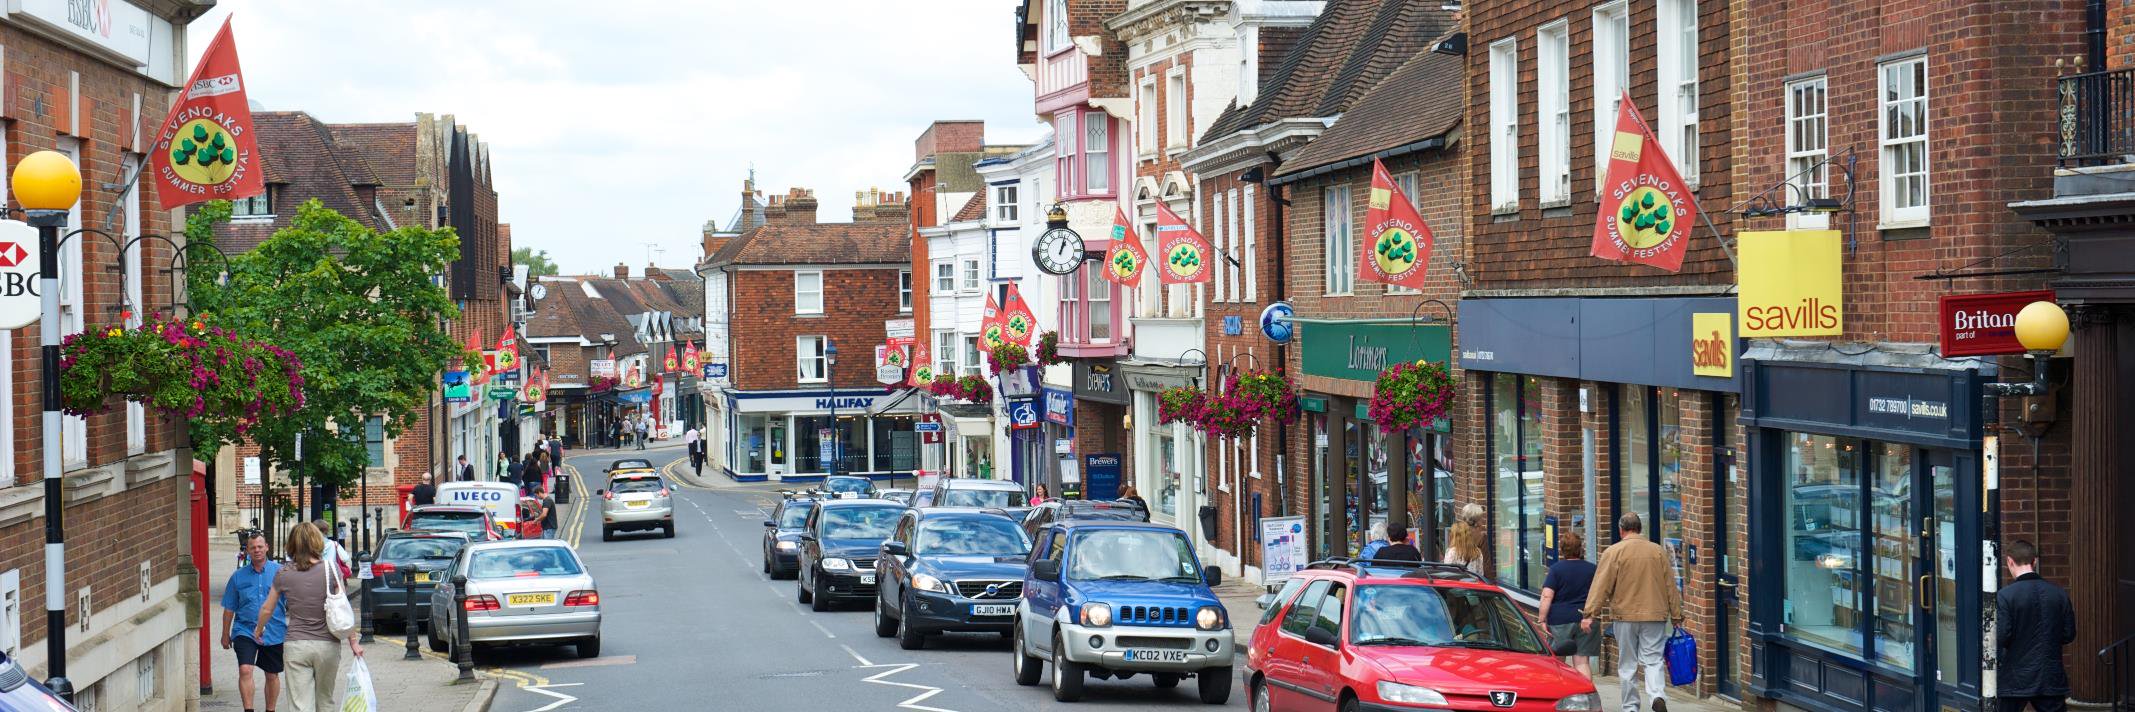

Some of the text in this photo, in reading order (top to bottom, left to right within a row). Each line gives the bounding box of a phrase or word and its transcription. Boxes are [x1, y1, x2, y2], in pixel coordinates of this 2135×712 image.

[67, 0, 97, 33] HSBC
[160, 106, 243, 150] SEVENOAKS
[1613, 149, 1640, 161] savills
[162, 149, 249, 195] SUMMER FESTIVAL
[1613, 173, 1687, 217] SEVENOAKS
[1371, 218, 1426, 249] SEVENOAKS
[1633, 229, 1683, 259] FESTIVAL
[1111, 243, 1142, 264] SEVNOAKS
[1164, 237, 1205, 254] SEVENOAKS
[1388, 258, 1423, 281] FESTIVAL
[1746, 297, 1838, 331] savills
[1956, 331, 1975, 340] part of
[1348, 335, 1387, 371] Lorimers
[1693, 330, 1727, 369] savills
[1088, 366, 1110, 392] Brewers
[816, 398, 873, 409] HALIFAX
[1869, 398, 1947, 417] 01732 789700 savills.co.uk
[1090, 457, 1118, 465] Brewers
[454, 491, 501, 501] IVECO
[512, 594, 552, 604] X322 SKE
[976, 606, 1012, 614] GJ10 HWA
[1134, 650, 1182, 661] KC02 VXE
